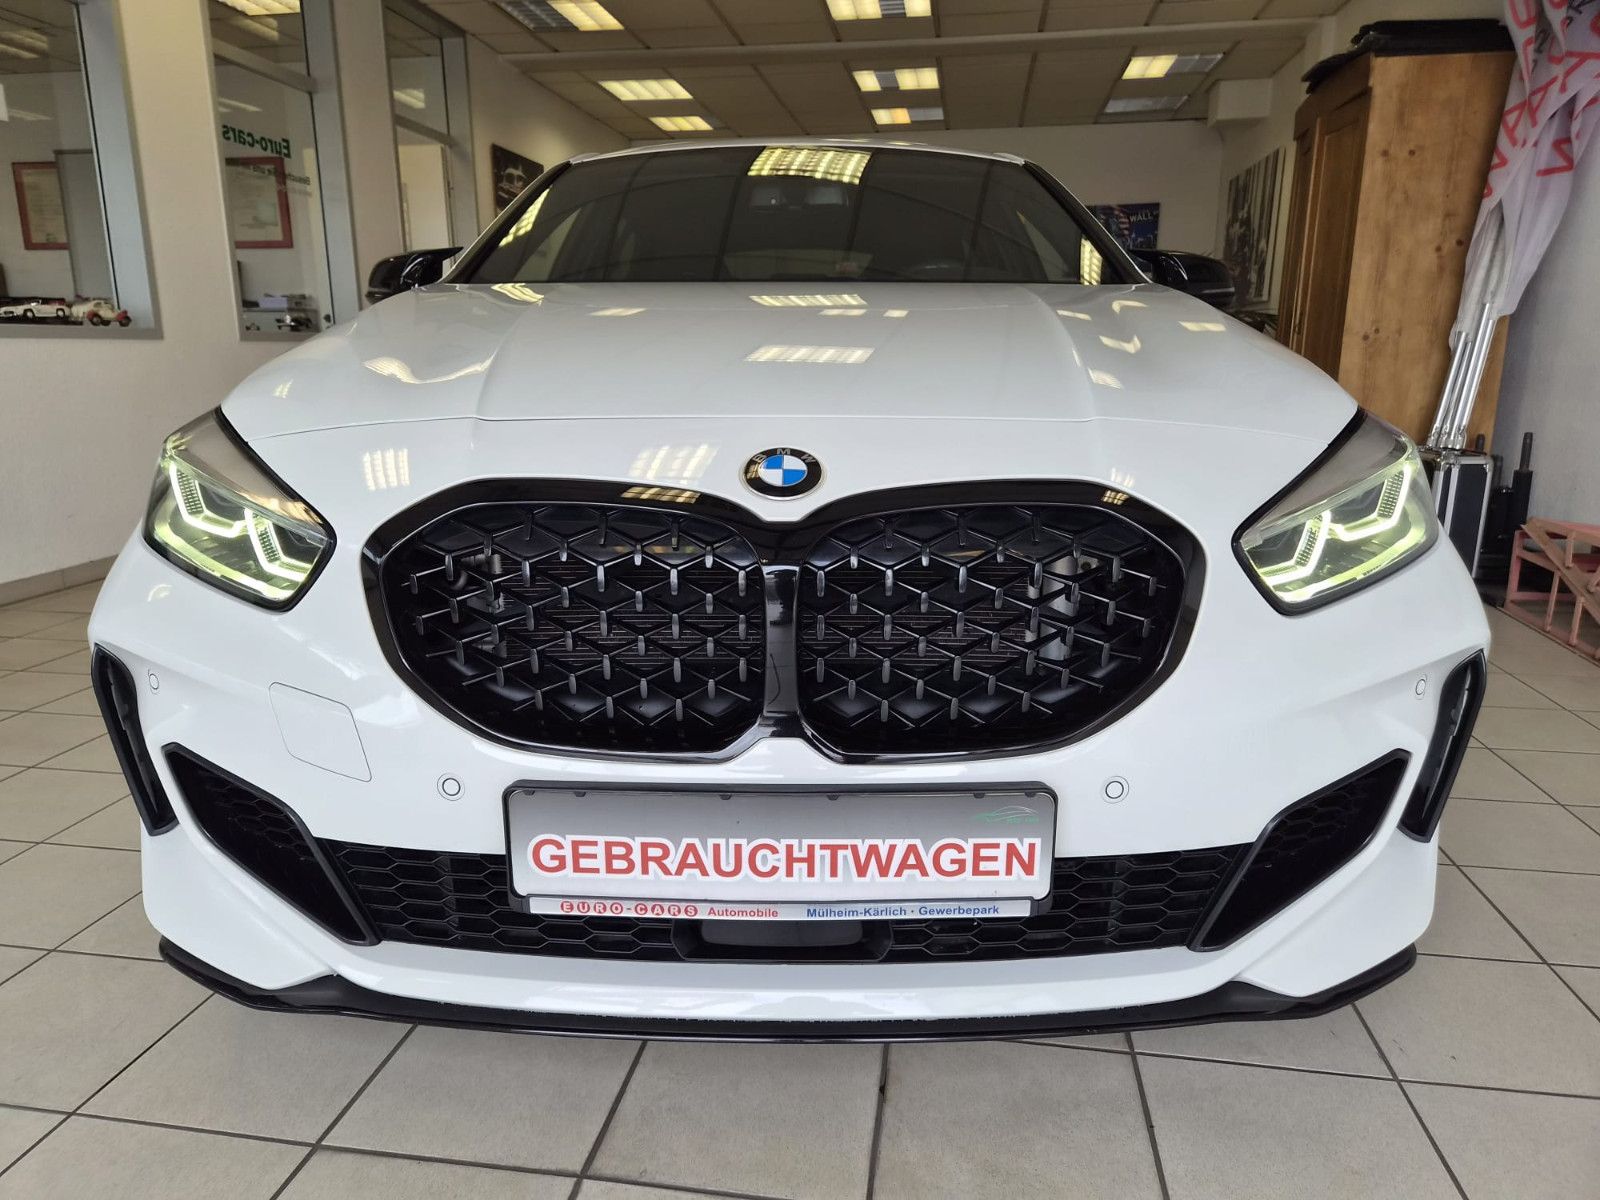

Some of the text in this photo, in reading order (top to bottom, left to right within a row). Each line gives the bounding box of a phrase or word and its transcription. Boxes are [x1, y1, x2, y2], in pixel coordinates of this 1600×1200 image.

[1129, 211, 1152, 221] WALL
[752, 448, 816, 463] BMW
[531, 838, 1036, 878] GEBRAUCHTWAGEN
[560, 901, 999, 919] EURO-CARS Automobile Mülheim-Kärlich Gewerbepark
